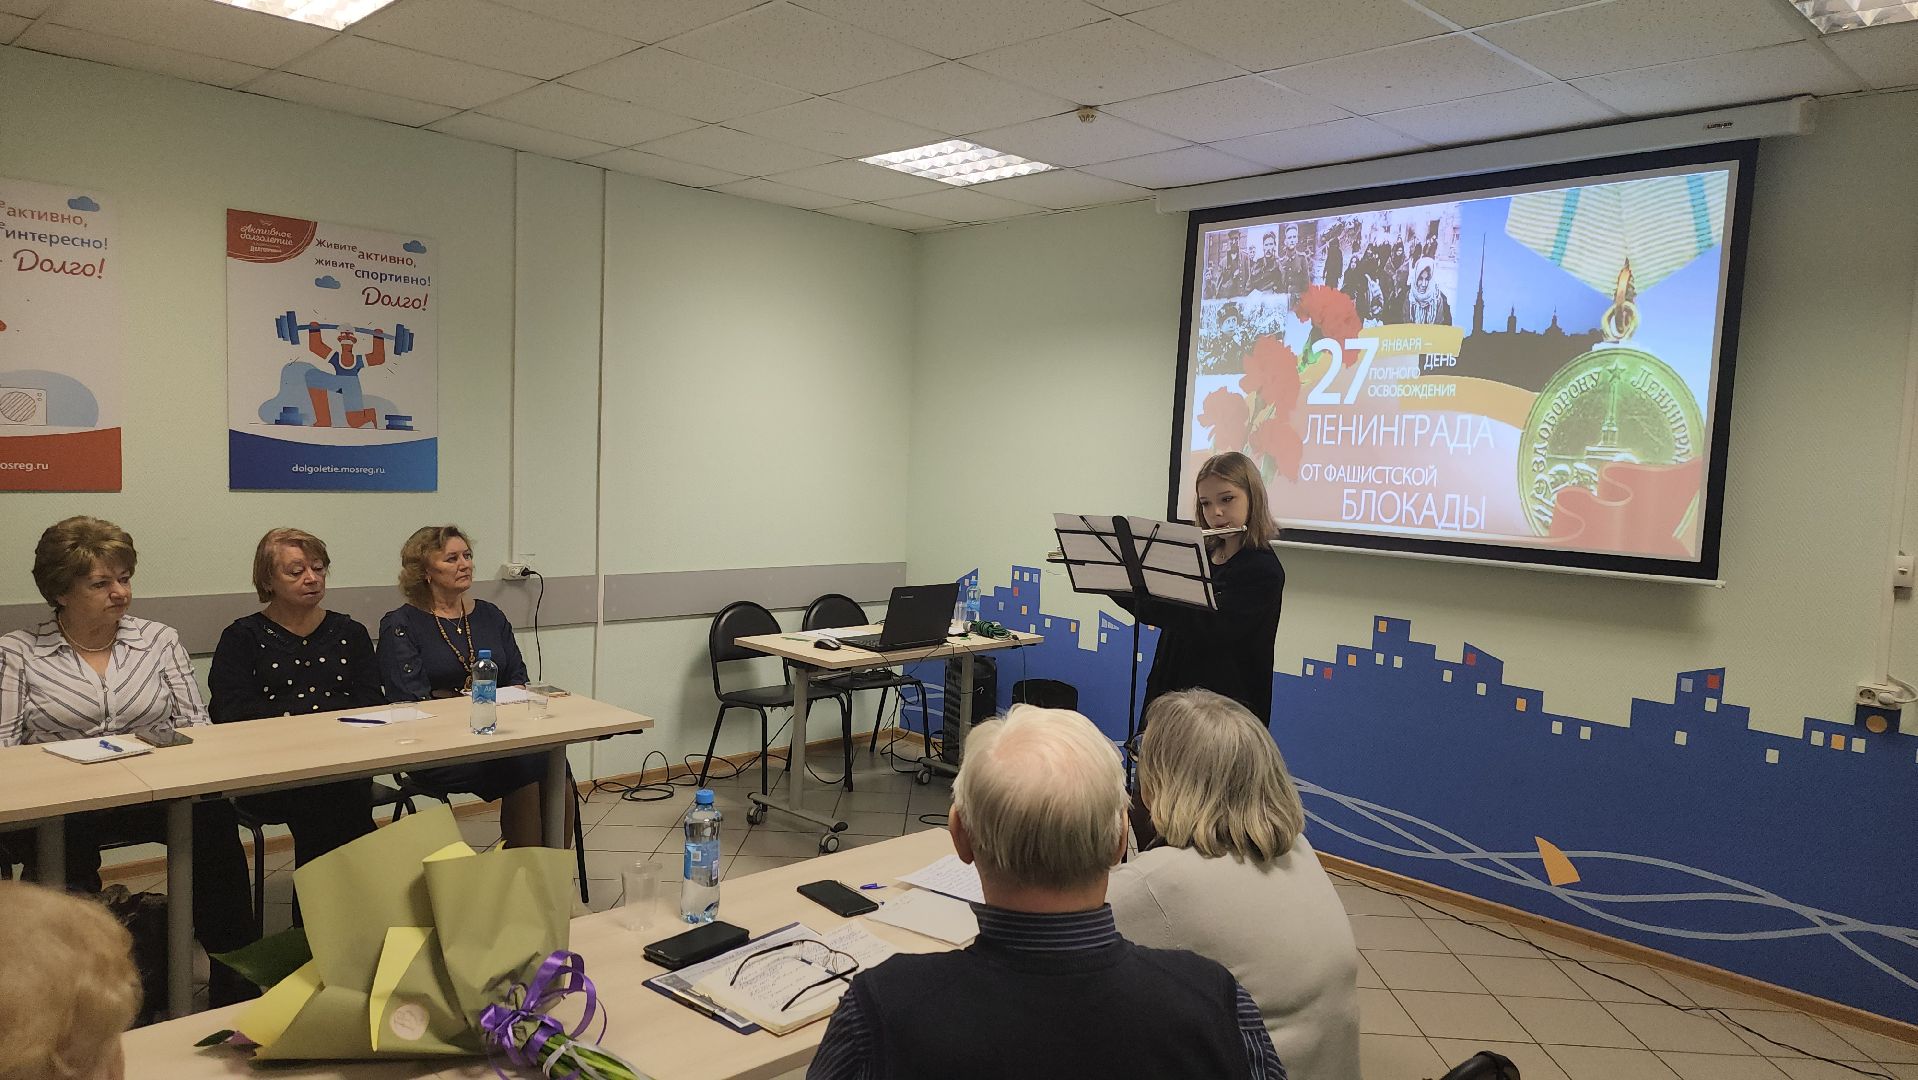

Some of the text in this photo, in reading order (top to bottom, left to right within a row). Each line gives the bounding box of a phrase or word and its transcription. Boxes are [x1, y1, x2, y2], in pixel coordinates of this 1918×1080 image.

[7, 207, 88, 229] активно,
[5, 229, 107, 250] интересно!
[13, 249, 105, 279] Долго!
[315, 238, 416, 268] Живите активно,
[314, 258, 431, 287] живите спортивно!
[361, 286, 428, 311] Долго!
[1382, 336, 1422, 352] ЯНВАРЯ
[1307, 337, 1379, 405] 27
[1368, 367, 1421, 381] ПОЛНОГО
[1424, 353, 1457, 370] ДЕНЬ
[1367, 384, 1457, 399] ОСВОБОЖДЕНИЯ
[1538, 367, 1601, 441] ОБОРОНУ
[1302, 413, 1495, 455] ЛЕНИНГРАДА
[291, 463, 385, 476] dolgoletie.mosreg.ru
[1300, 463, 1438, 488] ОТ ФАШИСТСКОЙ
[1341, 488, 1487, 532] БЛОКАДЫ
